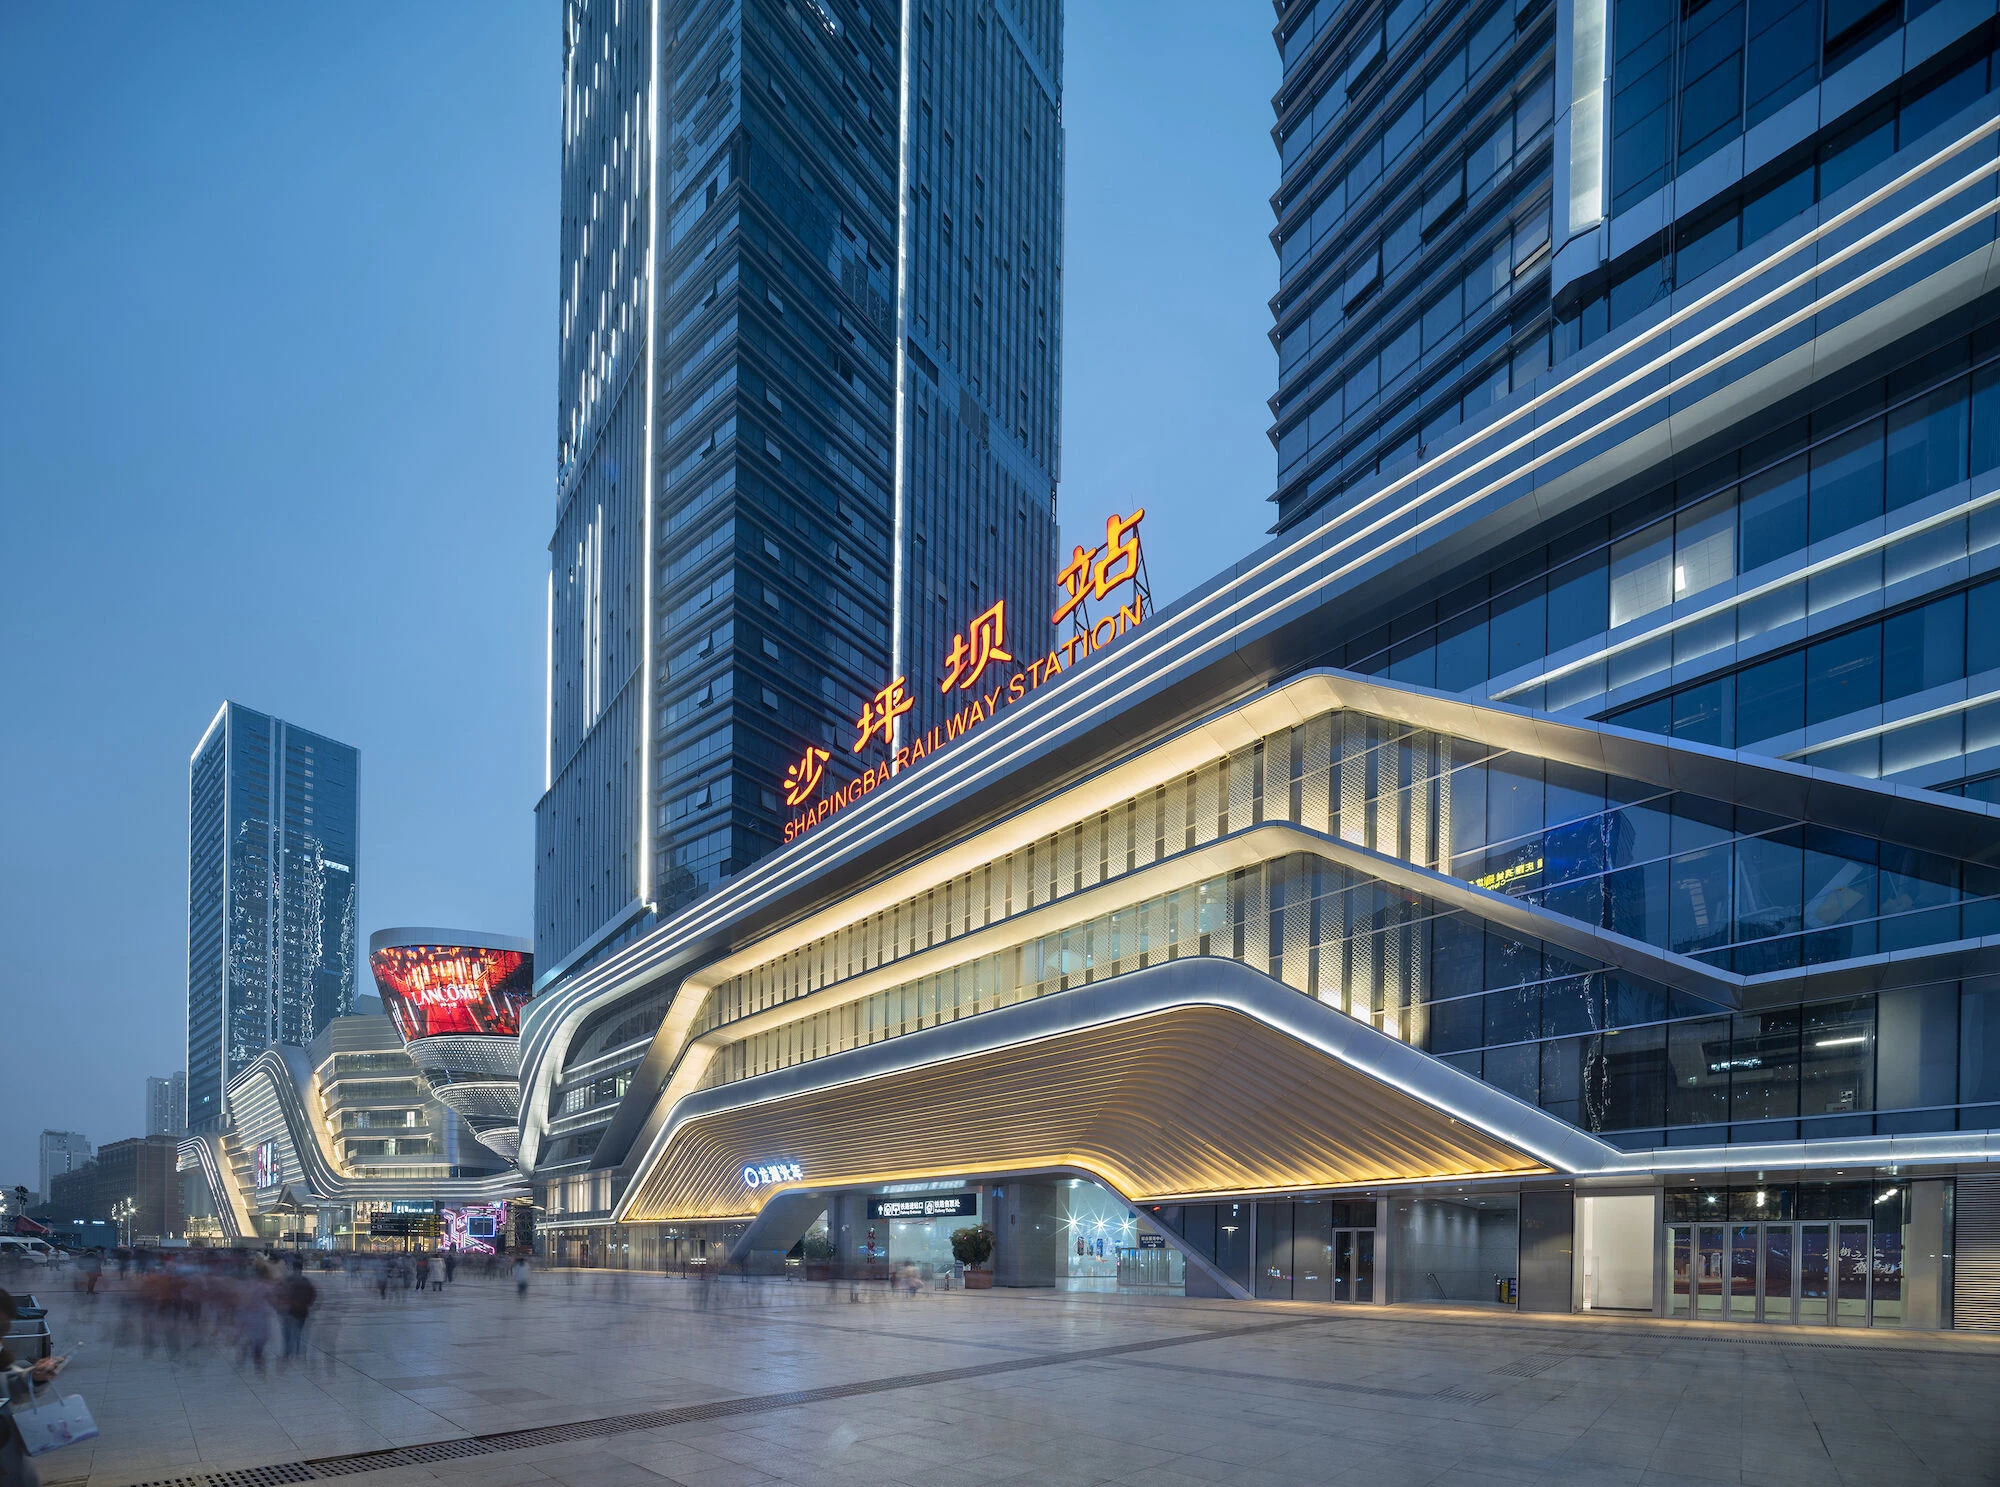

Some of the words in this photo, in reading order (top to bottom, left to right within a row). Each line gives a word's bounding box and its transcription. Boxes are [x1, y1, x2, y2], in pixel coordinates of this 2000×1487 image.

[783, 508, 1145, 807] 沙坪坝站
[783, 765, 891, 845] SHAPINGBA
[893, 684, 1001, 775] RAILWAY
[1006, 594, 1143, 706] STATION
